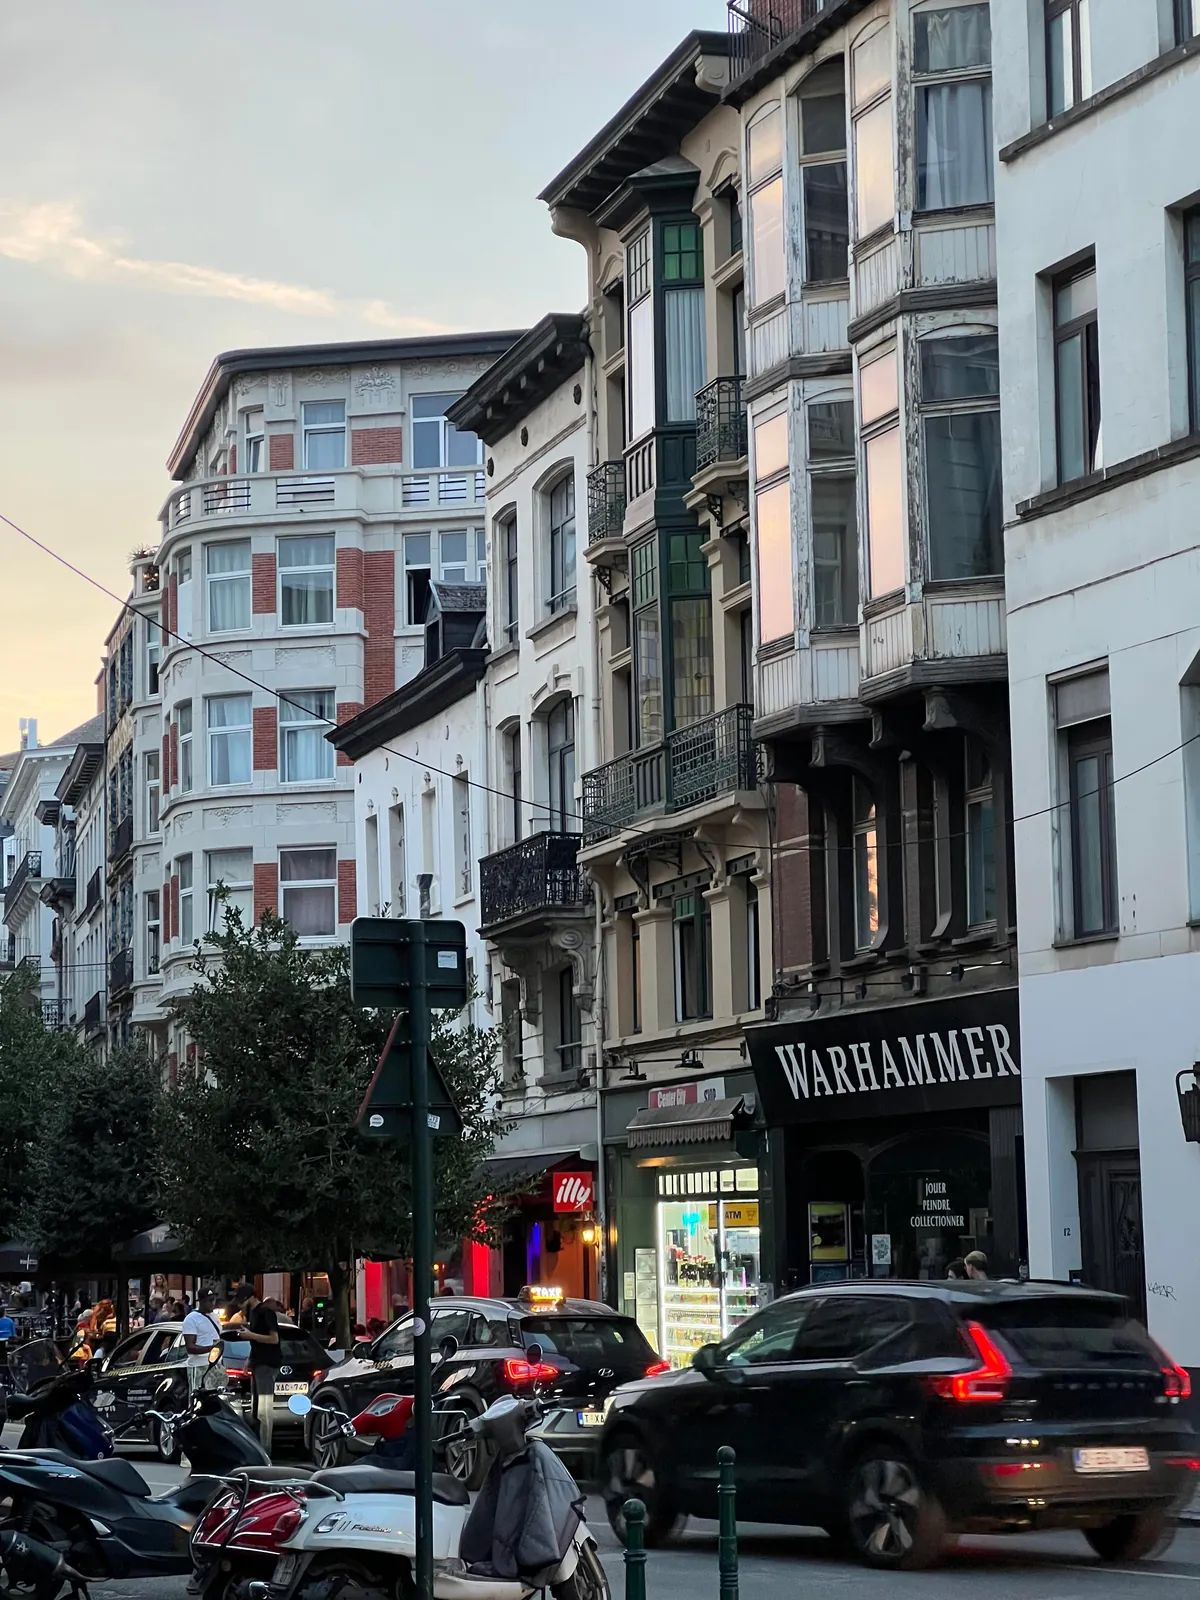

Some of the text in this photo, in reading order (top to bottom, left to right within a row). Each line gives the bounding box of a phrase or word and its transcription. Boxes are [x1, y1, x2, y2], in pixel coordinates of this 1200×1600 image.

[774, 1024, 1021, 1100] WARHAMMER
[556, 1177, 591, 1209] illy
[922, 1199, 951, 1211] PEINDRE
[725, 1210, 742, 1220] ATM
[910, 1215, 965, 1228] COLLECTIONNER
[1063, 1227, 1071, 1237] 12
[535, 1286, 562, 1298] TAXI
